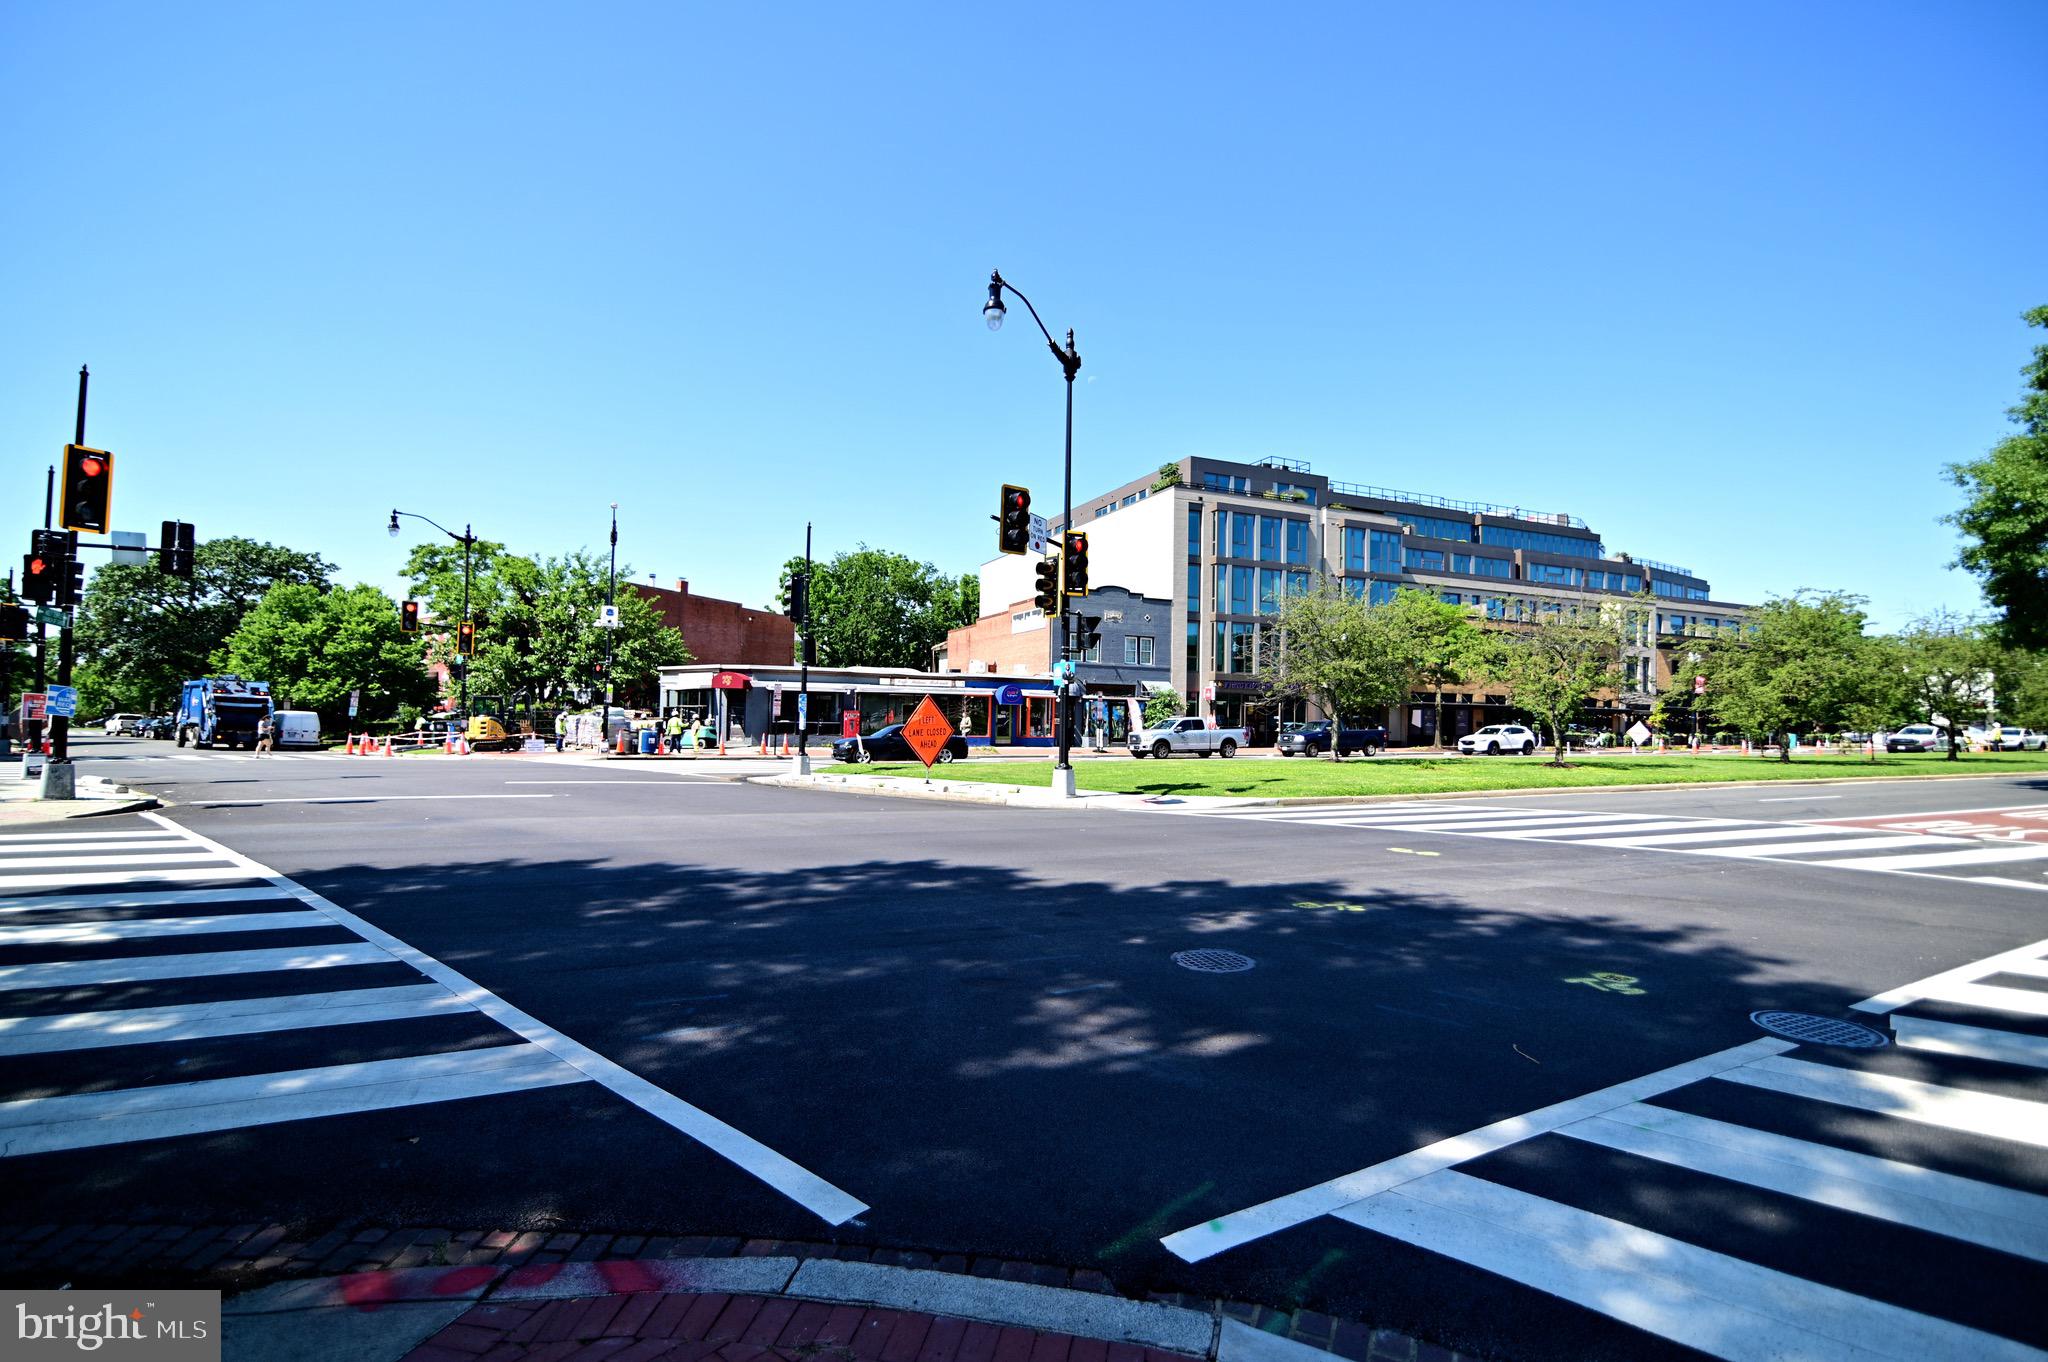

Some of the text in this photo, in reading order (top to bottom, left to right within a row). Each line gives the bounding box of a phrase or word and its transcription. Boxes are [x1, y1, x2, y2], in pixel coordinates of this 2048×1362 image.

[1034, 518, 1042, 526] NO
[1033, 526, 1044, 535] TURN
[1037, 535, 1045, 543] RED
[922, 716, 935, 724] LEFT
[908, 727, 947, 737] LANE CLOSED
[920, 740, 938, 748] AHEAD
